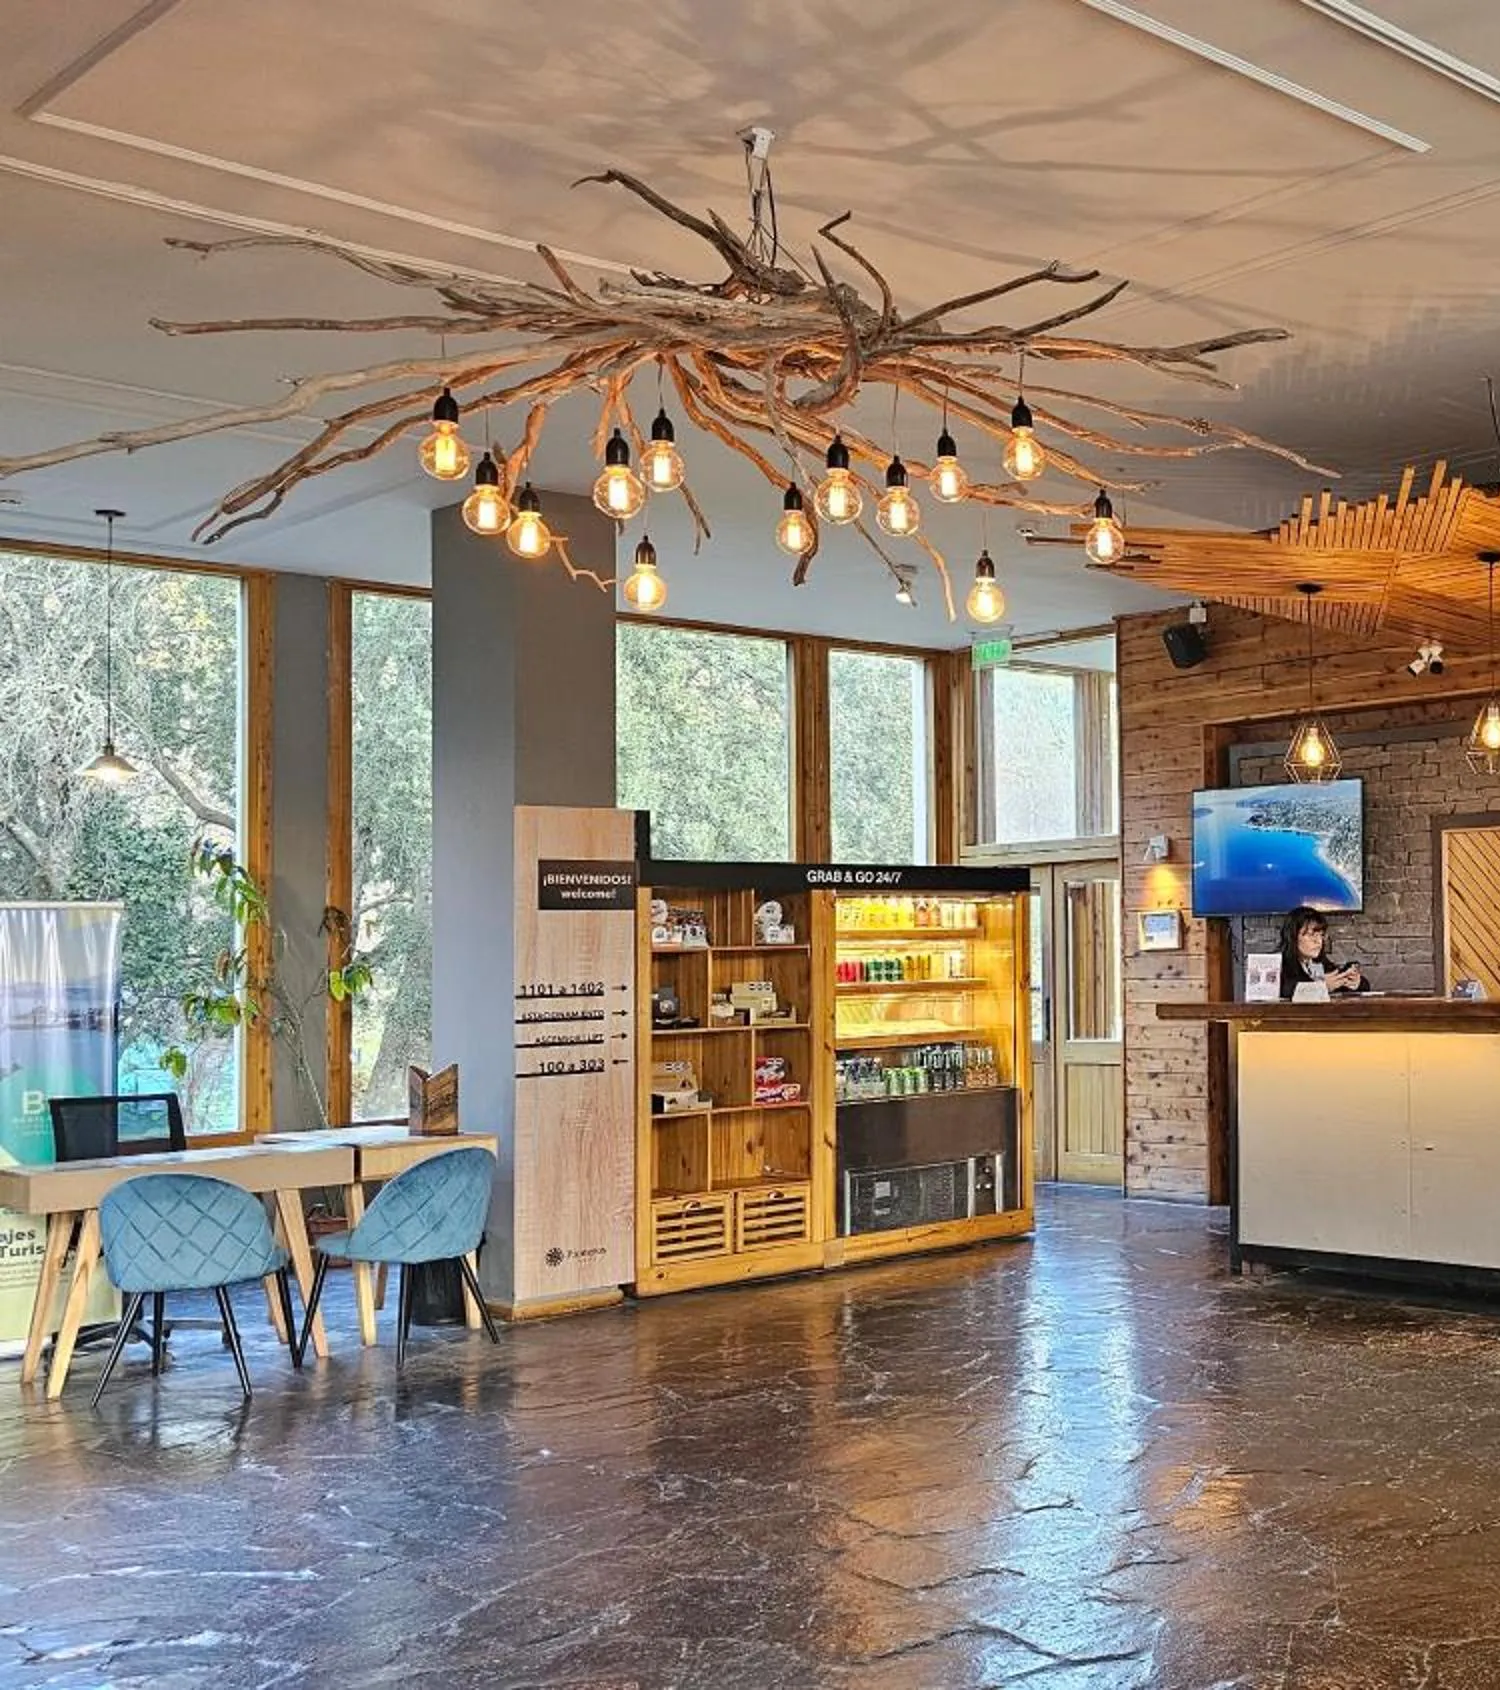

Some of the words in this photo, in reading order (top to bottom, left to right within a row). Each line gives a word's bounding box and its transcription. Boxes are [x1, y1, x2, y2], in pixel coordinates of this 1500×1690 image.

[543, 873, 632, 886] ¡BIENVENIDOS!
[807, 870, 842, 883] GRAB
[844, 871, 853, 883] &
[855, 871, 875, 883] GO
[875, 871, 902, 884] 24/7
[520, 984, 553, 996] 1101
[571, 982, 604, 995] 1402
[539, 1061, 565, 1074] 100
[580, 1059, 604, 1072] 303
